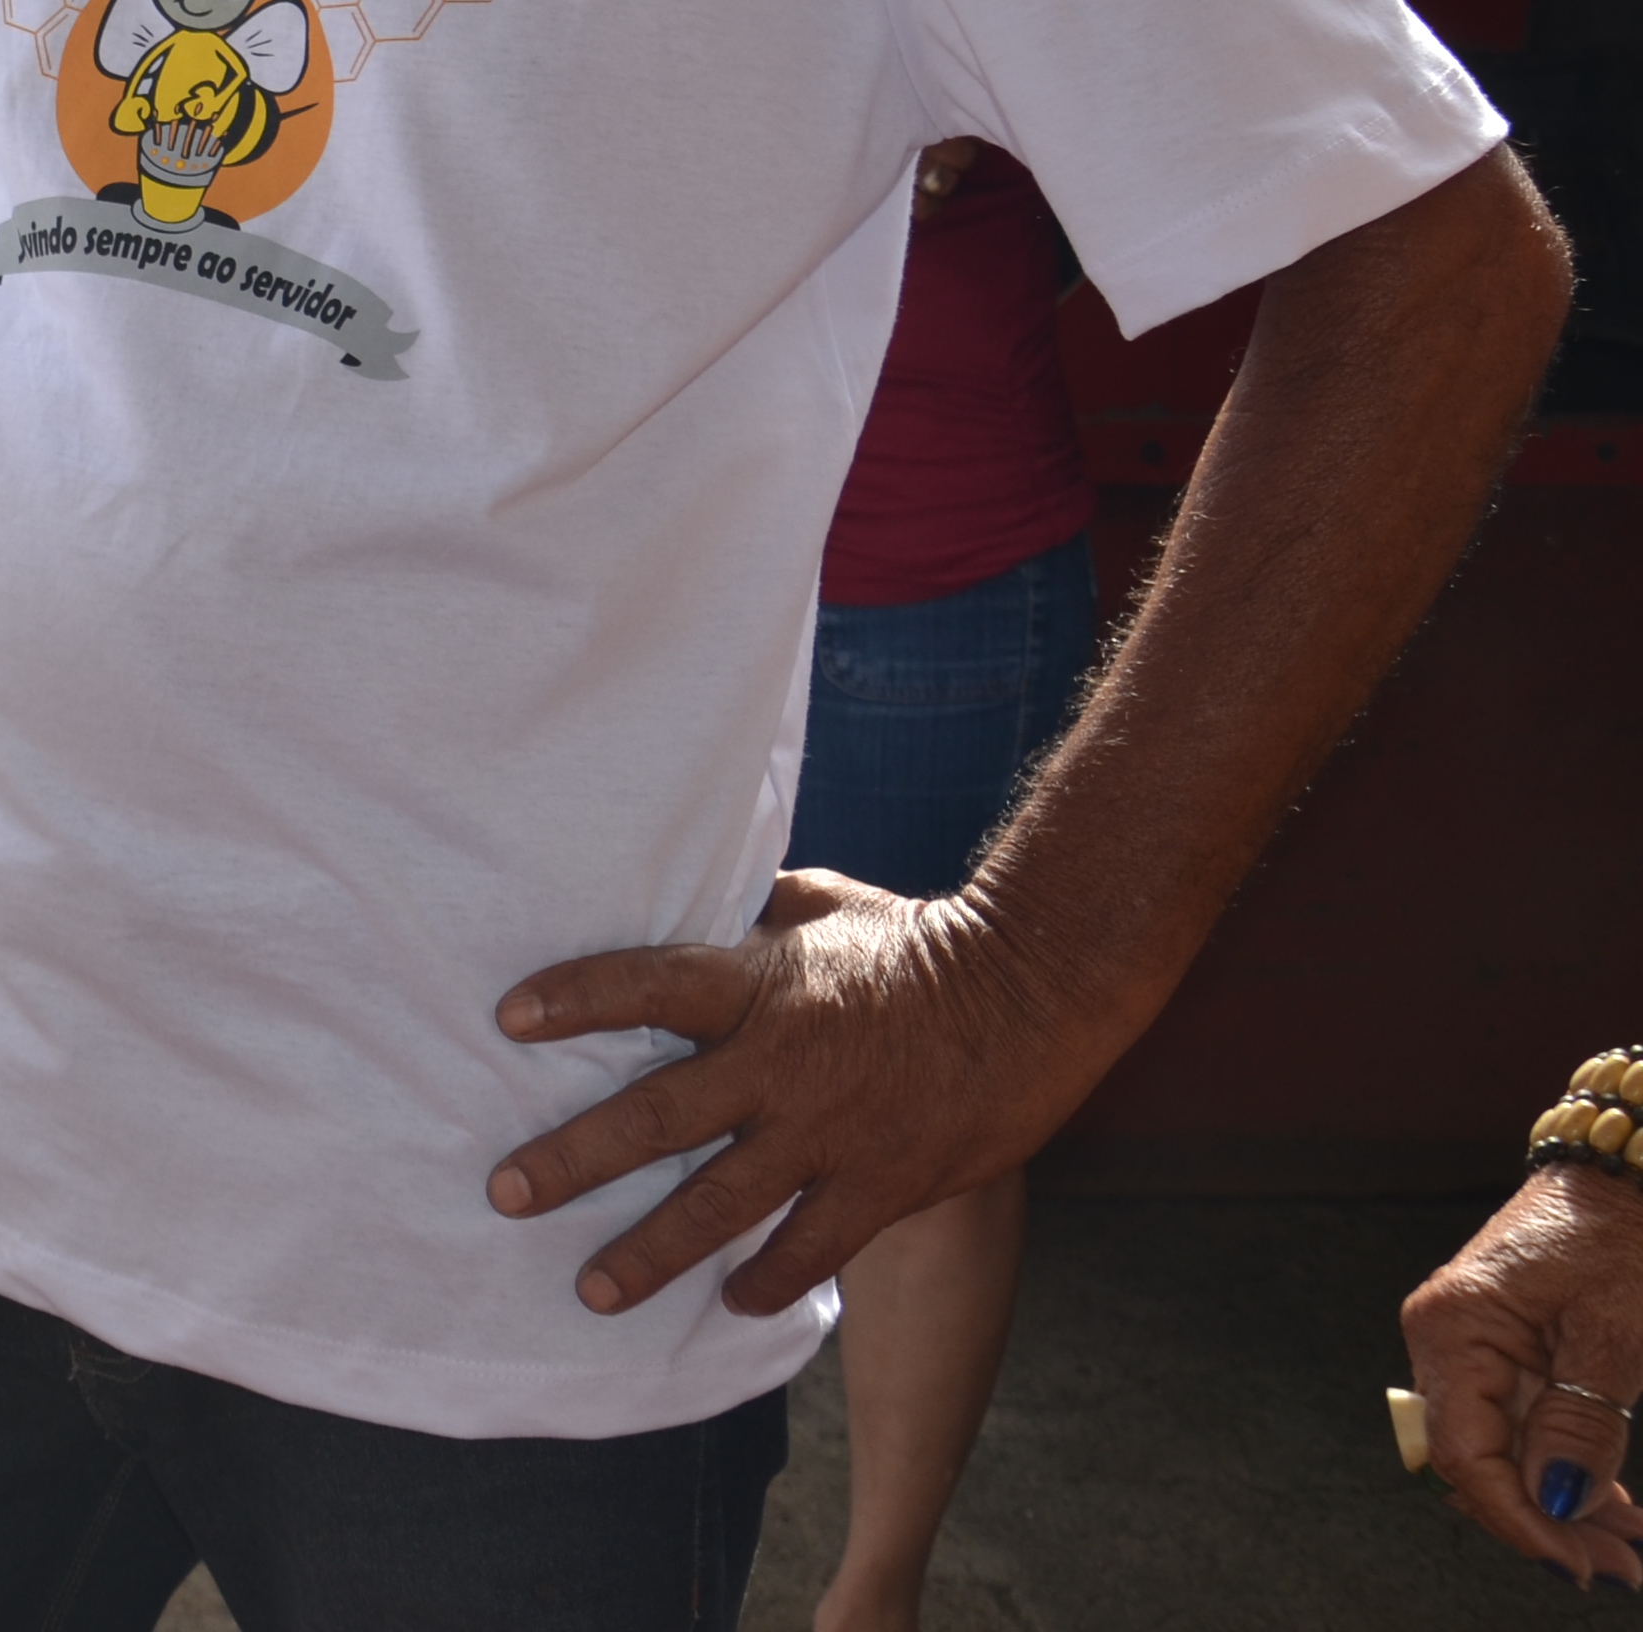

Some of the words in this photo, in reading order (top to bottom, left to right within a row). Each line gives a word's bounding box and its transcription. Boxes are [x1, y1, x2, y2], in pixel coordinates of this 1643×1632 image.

[83, 225, 191, 271] sempre
[197, 249, 237, 284] ao
[240, 264, 357, 331] servidor
